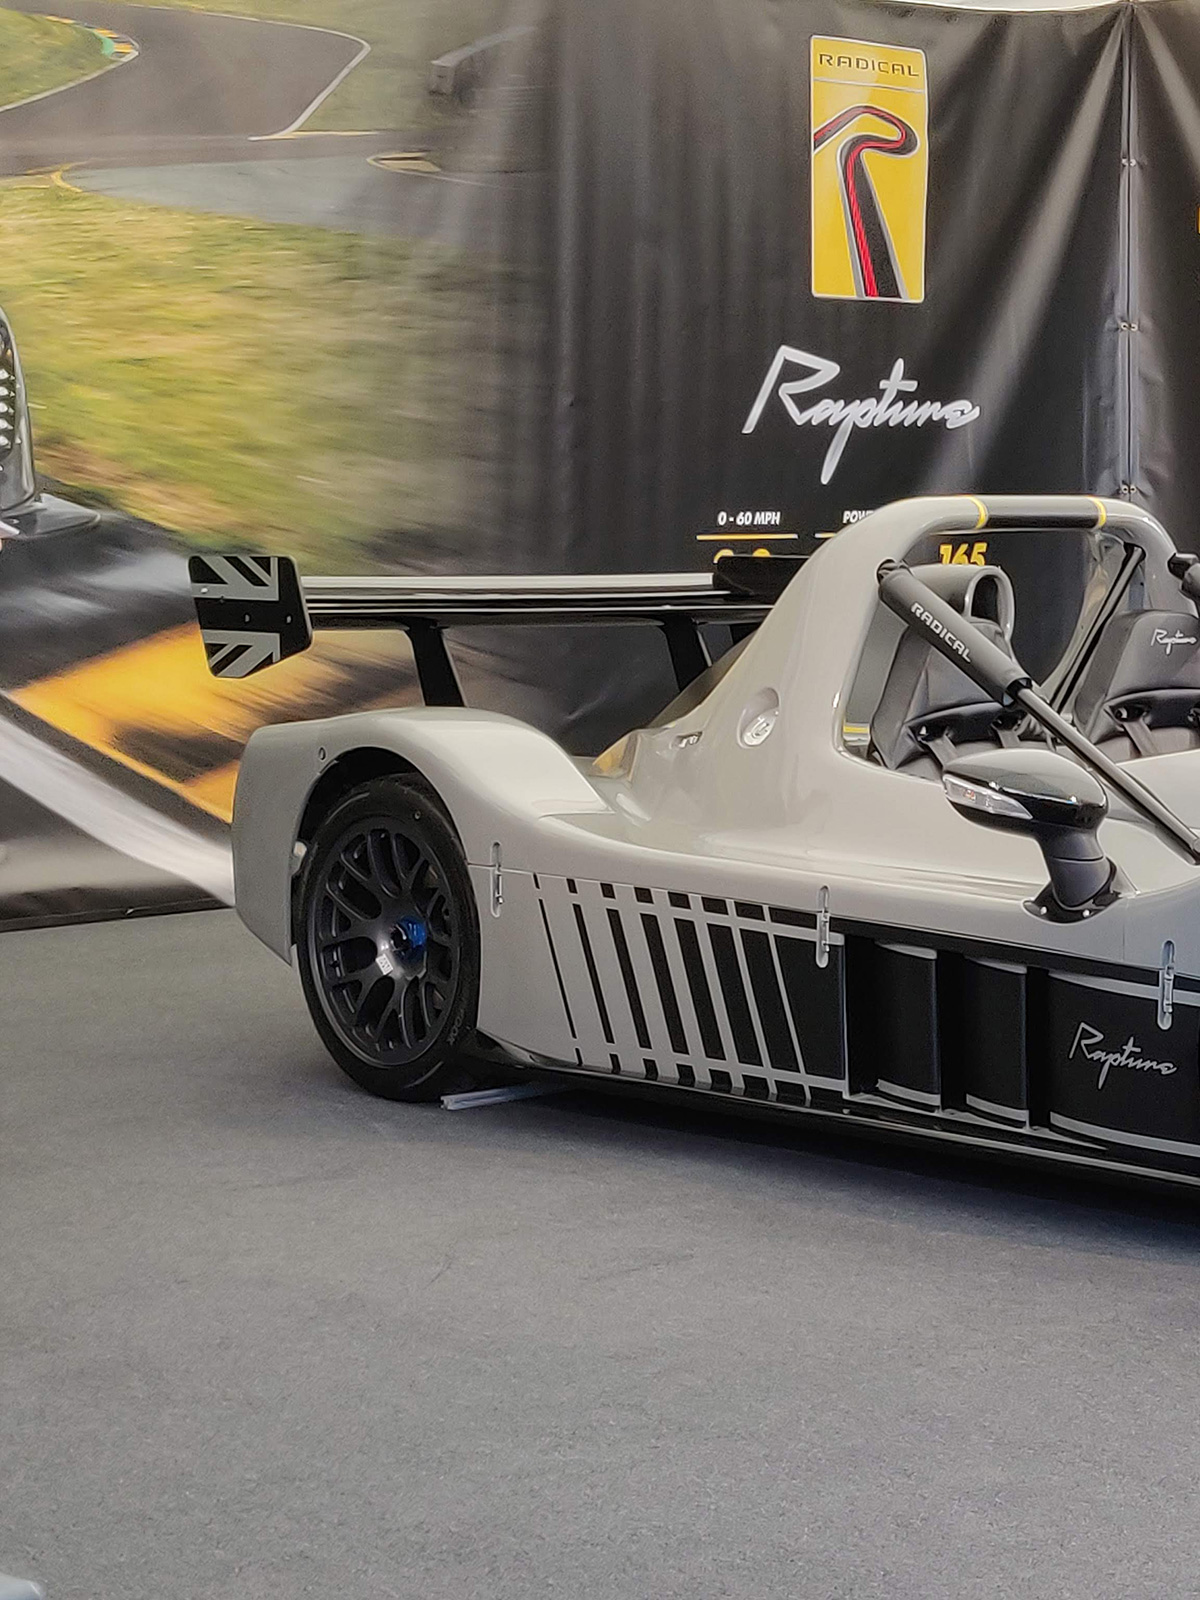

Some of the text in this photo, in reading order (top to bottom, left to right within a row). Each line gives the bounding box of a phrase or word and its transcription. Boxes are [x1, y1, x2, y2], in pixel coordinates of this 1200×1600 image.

[819, 53, 919, 77] RADICAL
[742, 345, 980, 485] Rapture
[717, 511, 727, 526] 0
[736, 511, 752, 526] 60
[753, 511, 781, 526] MPH
[911, 602, 971, 663] RADICAL
[1069, 1021, 1178, 1090] Rapture
